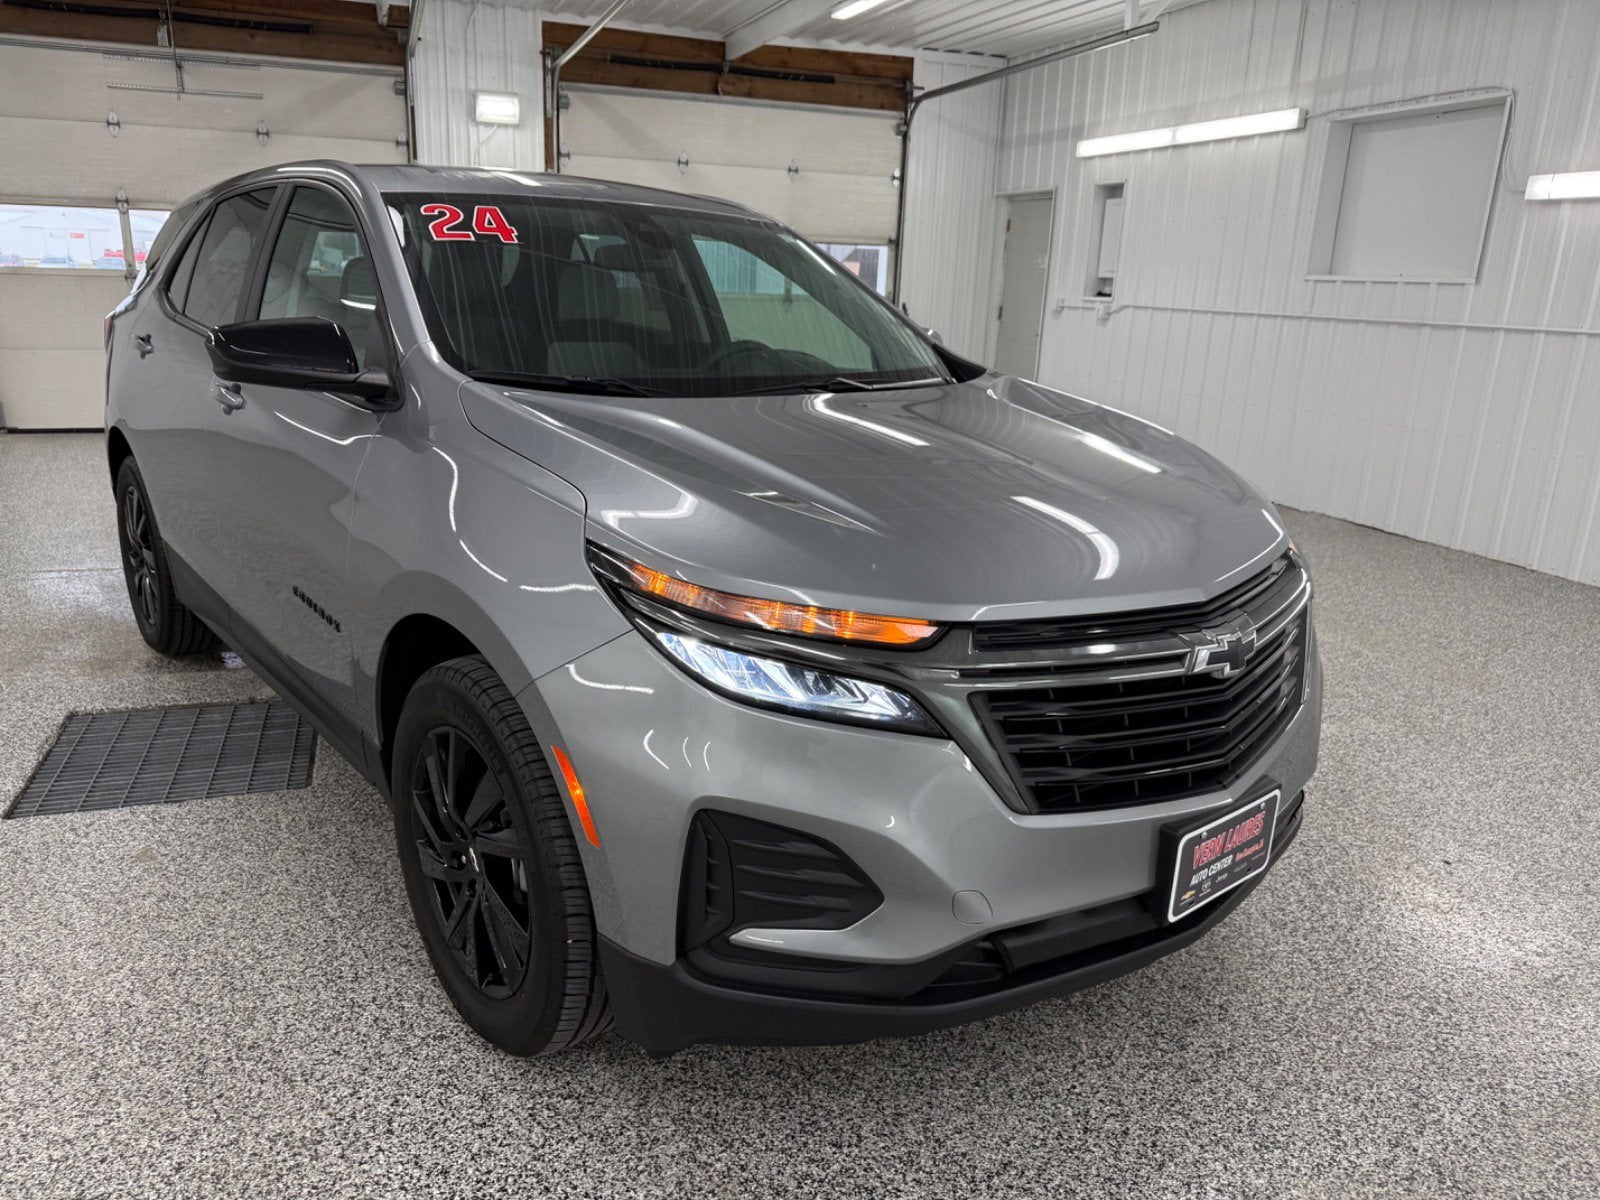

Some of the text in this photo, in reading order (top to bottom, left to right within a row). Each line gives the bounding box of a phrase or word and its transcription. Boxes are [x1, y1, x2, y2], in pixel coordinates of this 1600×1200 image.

[420, 203, 518, 243] 24
[1193, 832, 1226, 870] VERN
[1224, 811, 1265, 853] LAURES
[1190, 868, 1208, 887] AUTO
[1208, 854, 1233, 876] CENTER
